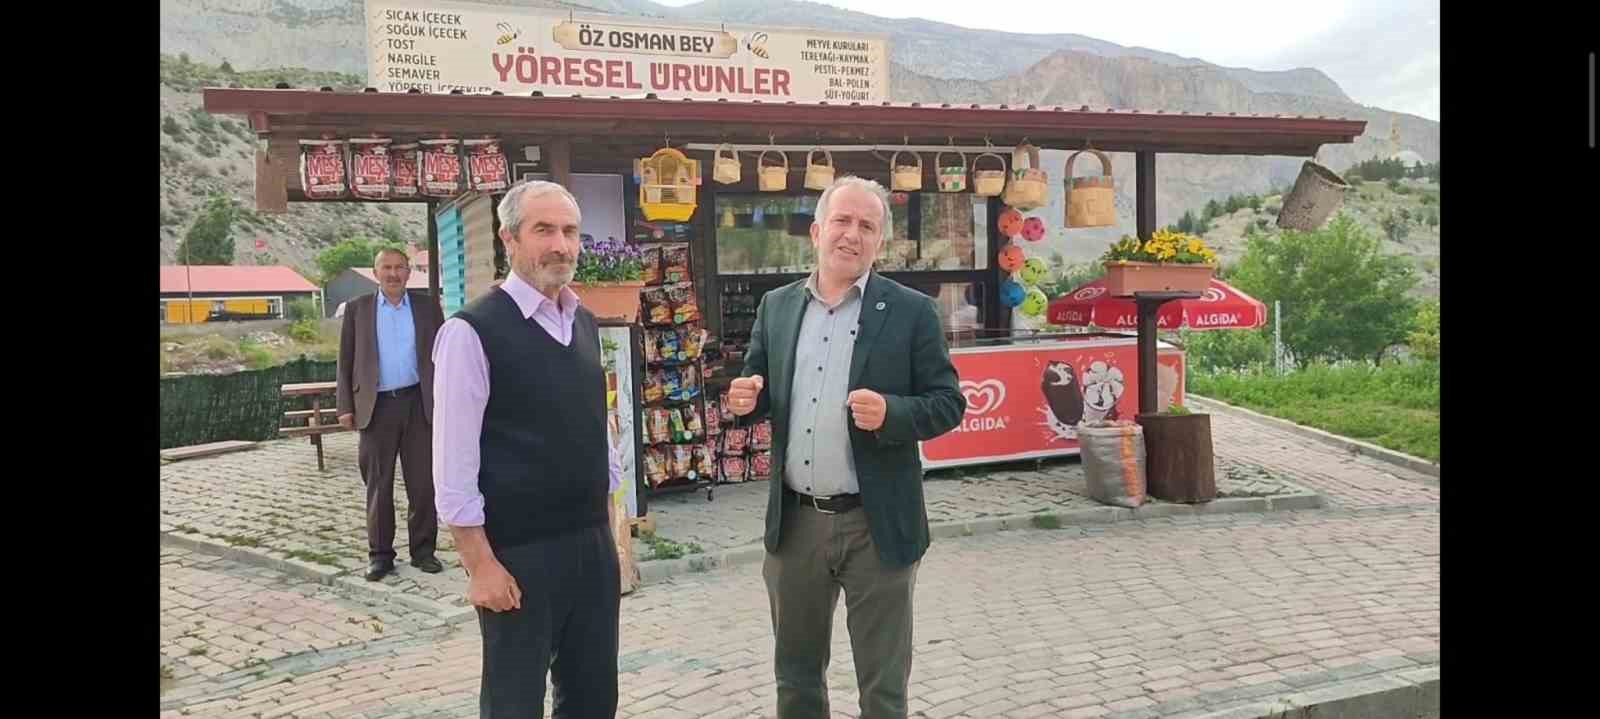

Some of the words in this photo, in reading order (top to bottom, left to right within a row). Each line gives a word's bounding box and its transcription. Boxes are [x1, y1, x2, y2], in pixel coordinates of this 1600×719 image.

[386, 9, 419, 22] SICAK
[423, 11, 461, 25] İÇECEK
[386, 23, 425, 37] SOĞUK
[428, 27, 467, 40] İÇECEK
[579, 24, 604, 47] ÖZ
[608, 31, 675, 51] OSMAN
[680, 35, 714, 53] BEY
[387, 38, 415, 50] TOST
[387, 53, 437, 66] NARGİLE
[388, 67, 440, 80] SEMAVER
[492, 47, 642, 90] YÖRESEL
[650, 62, 791, 96] ÜRÜNLER
[1196, 313, 1238, 326] ALGIDA
